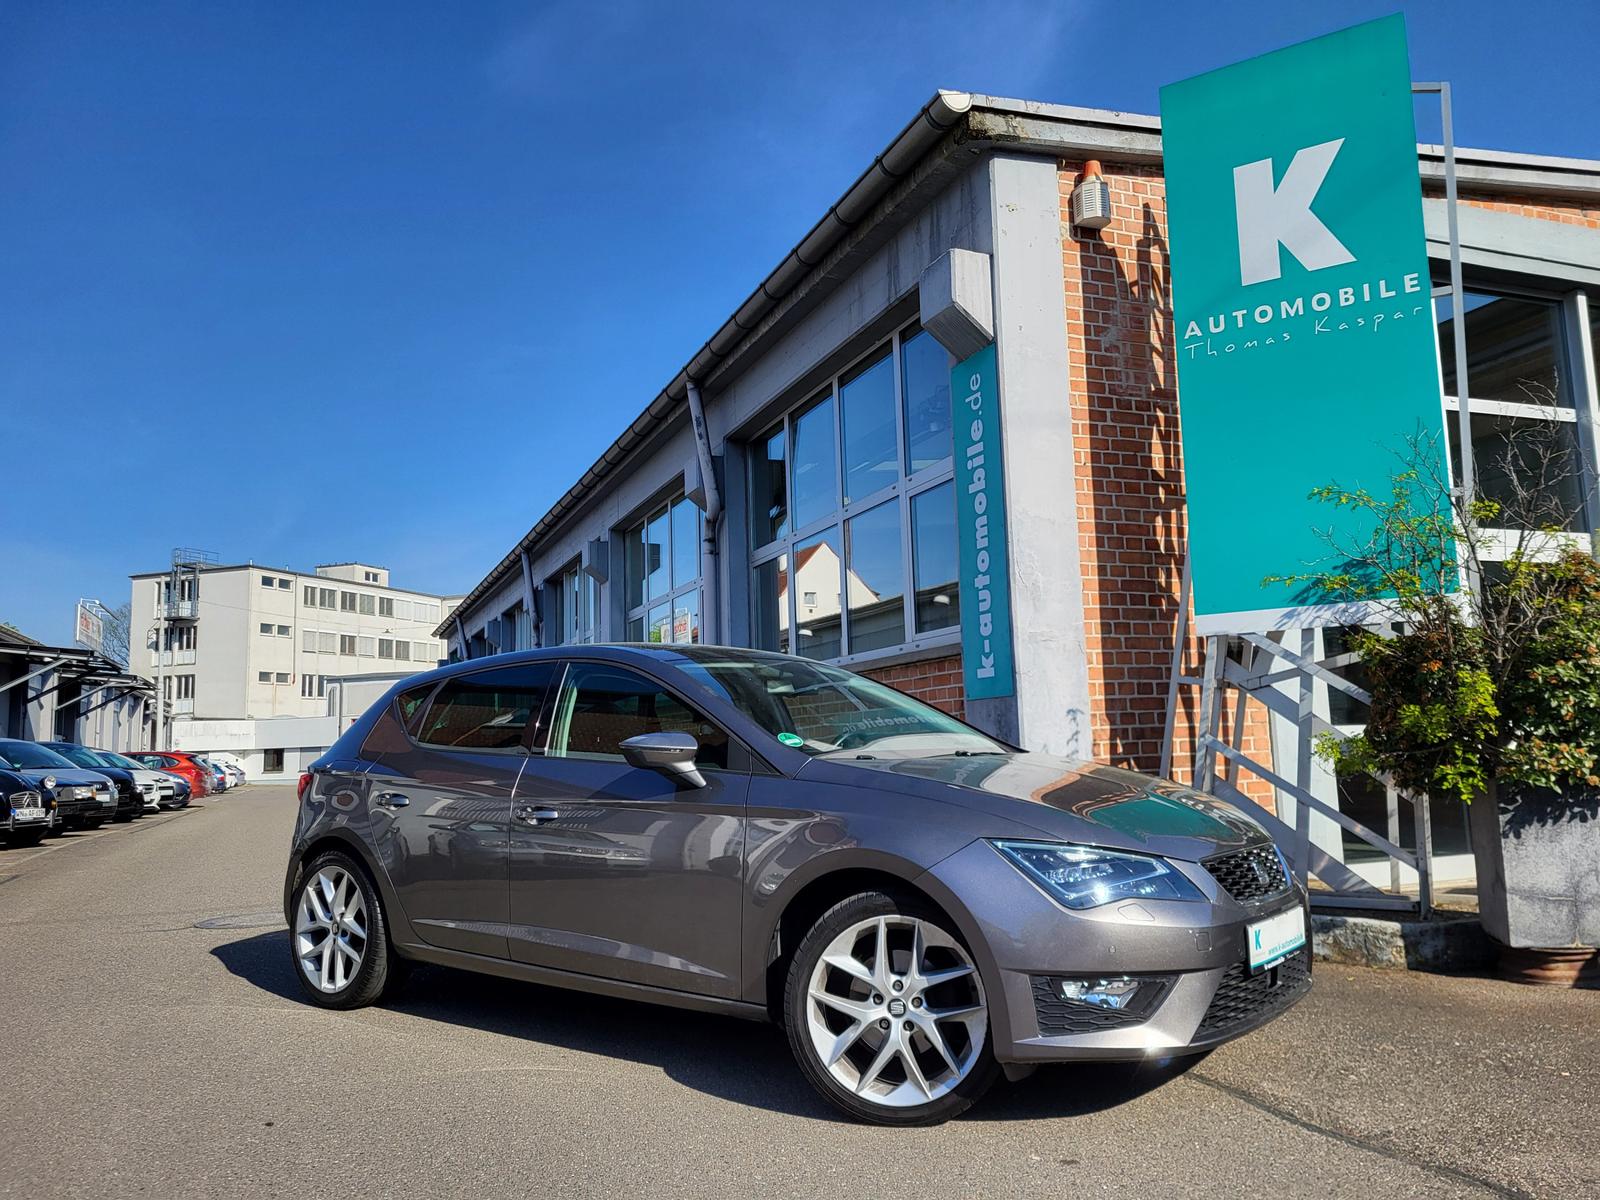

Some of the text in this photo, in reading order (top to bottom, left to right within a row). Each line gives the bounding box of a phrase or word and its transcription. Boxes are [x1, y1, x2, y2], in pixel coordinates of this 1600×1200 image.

[1233, 137, 1357, 286] K
[1184, 273, 1420, 339] AUTOMOBILE
[1185, 306, 1423, 359] Thomas Kaspar
[965, 372, 996, 678] k-automobile.de
[1254, 928, 1262, 951] K
